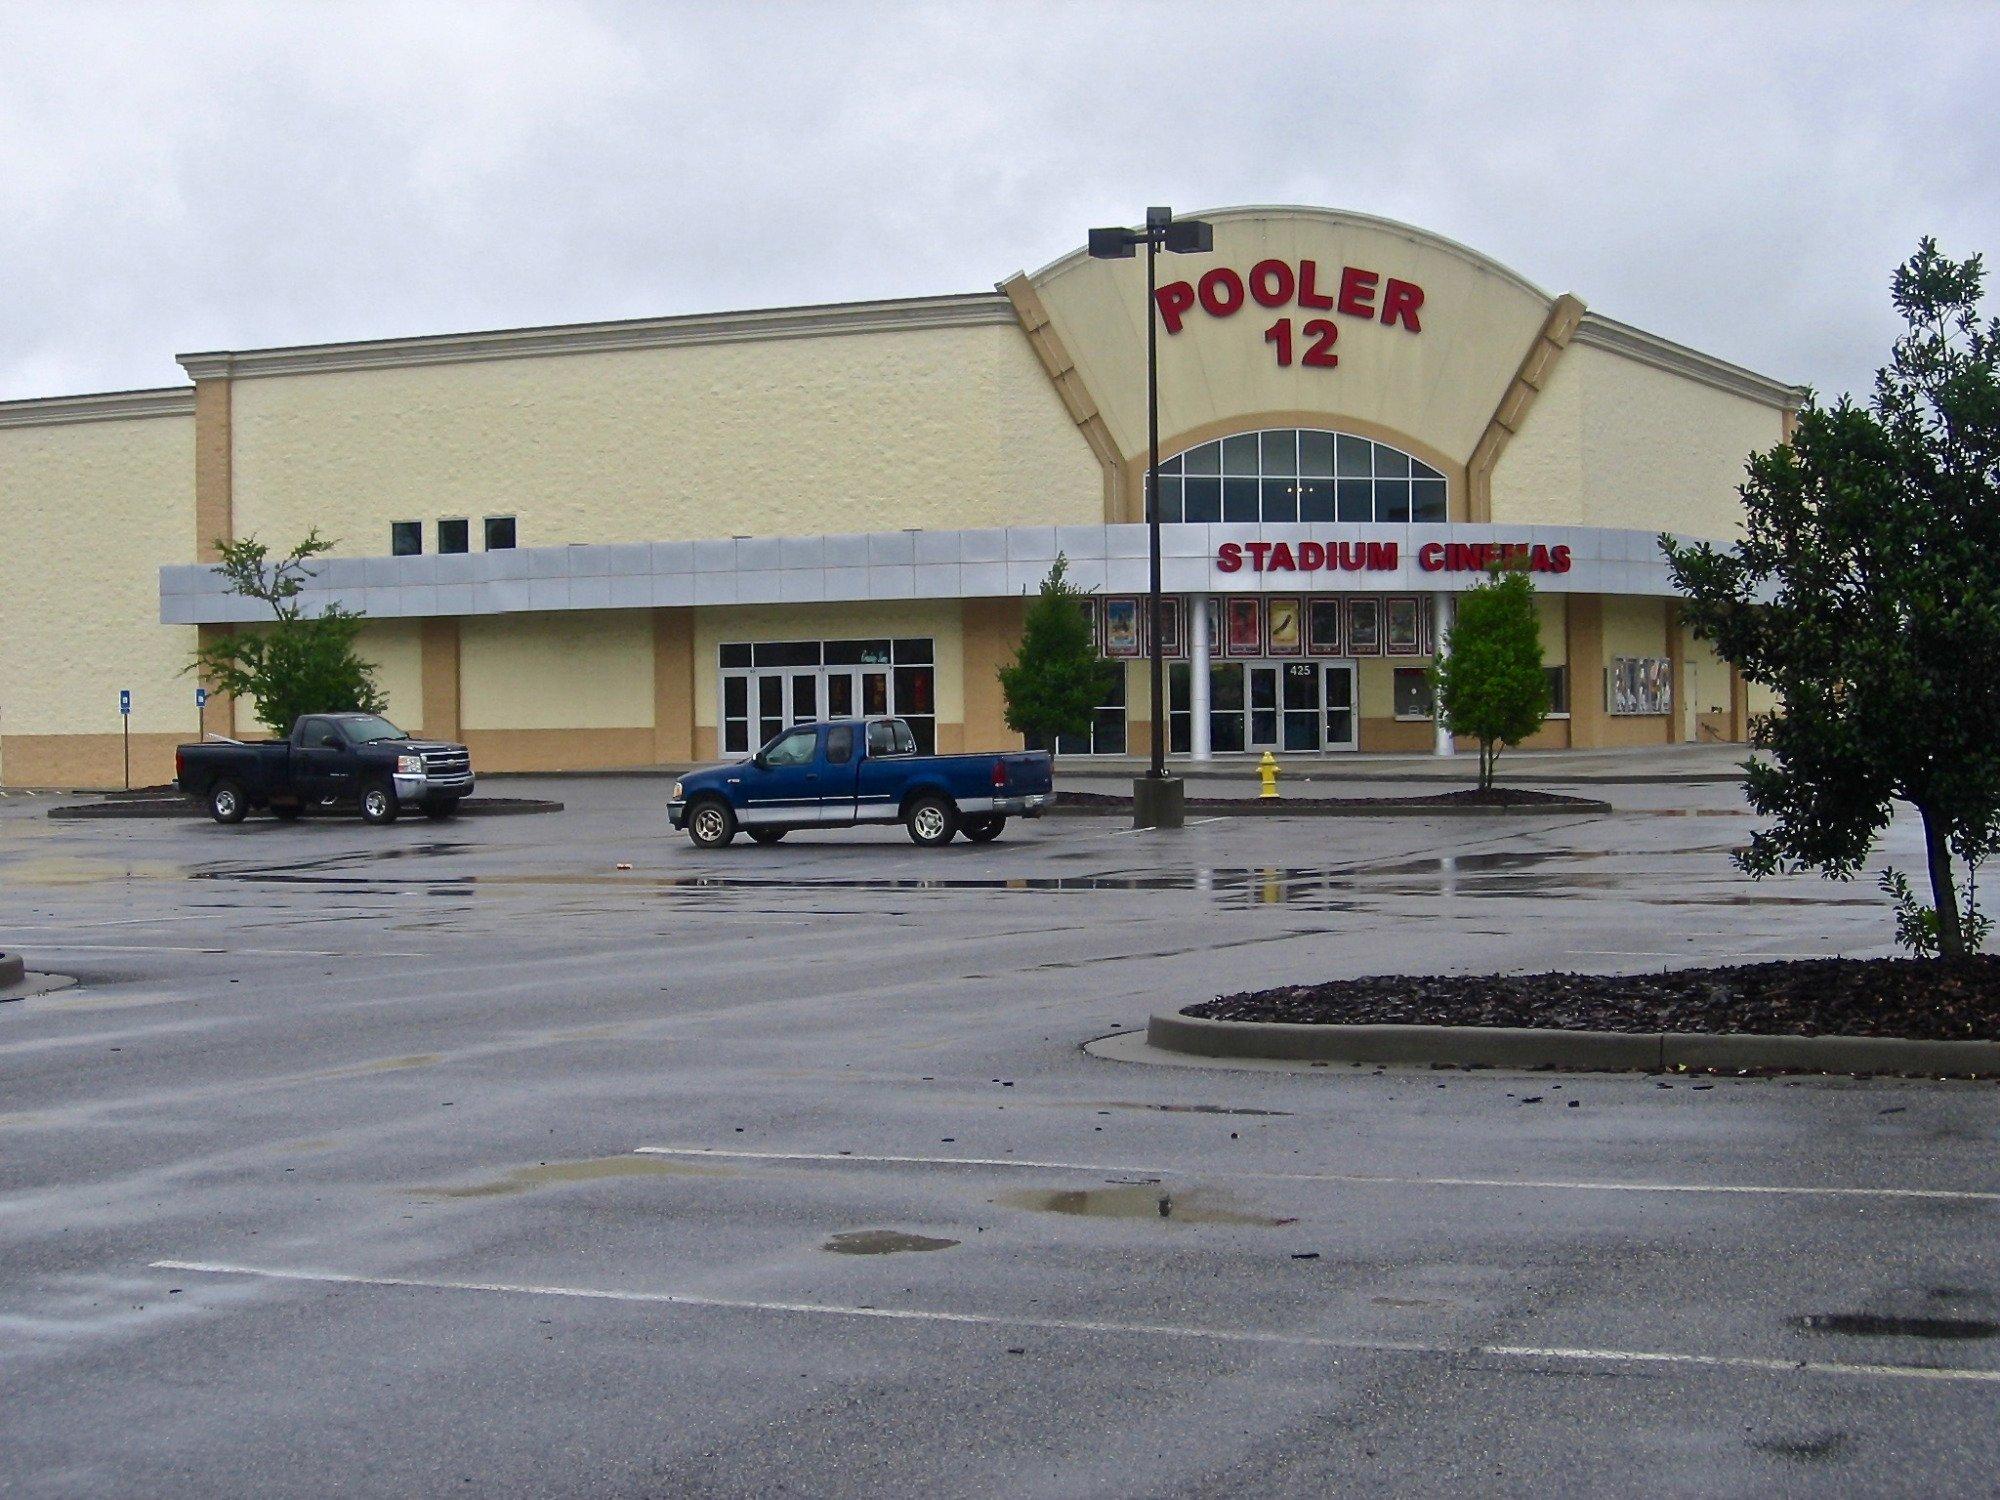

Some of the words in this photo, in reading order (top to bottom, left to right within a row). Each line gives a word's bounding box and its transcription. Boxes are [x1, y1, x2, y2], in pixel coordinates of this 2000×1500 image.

[1155, 259, 1425, 336] POOLER
[1265, 318, 1339, 368] 12
[1217, 542, 1398, 573] STADIUM
[1289, 665, 1311, 676] 425
